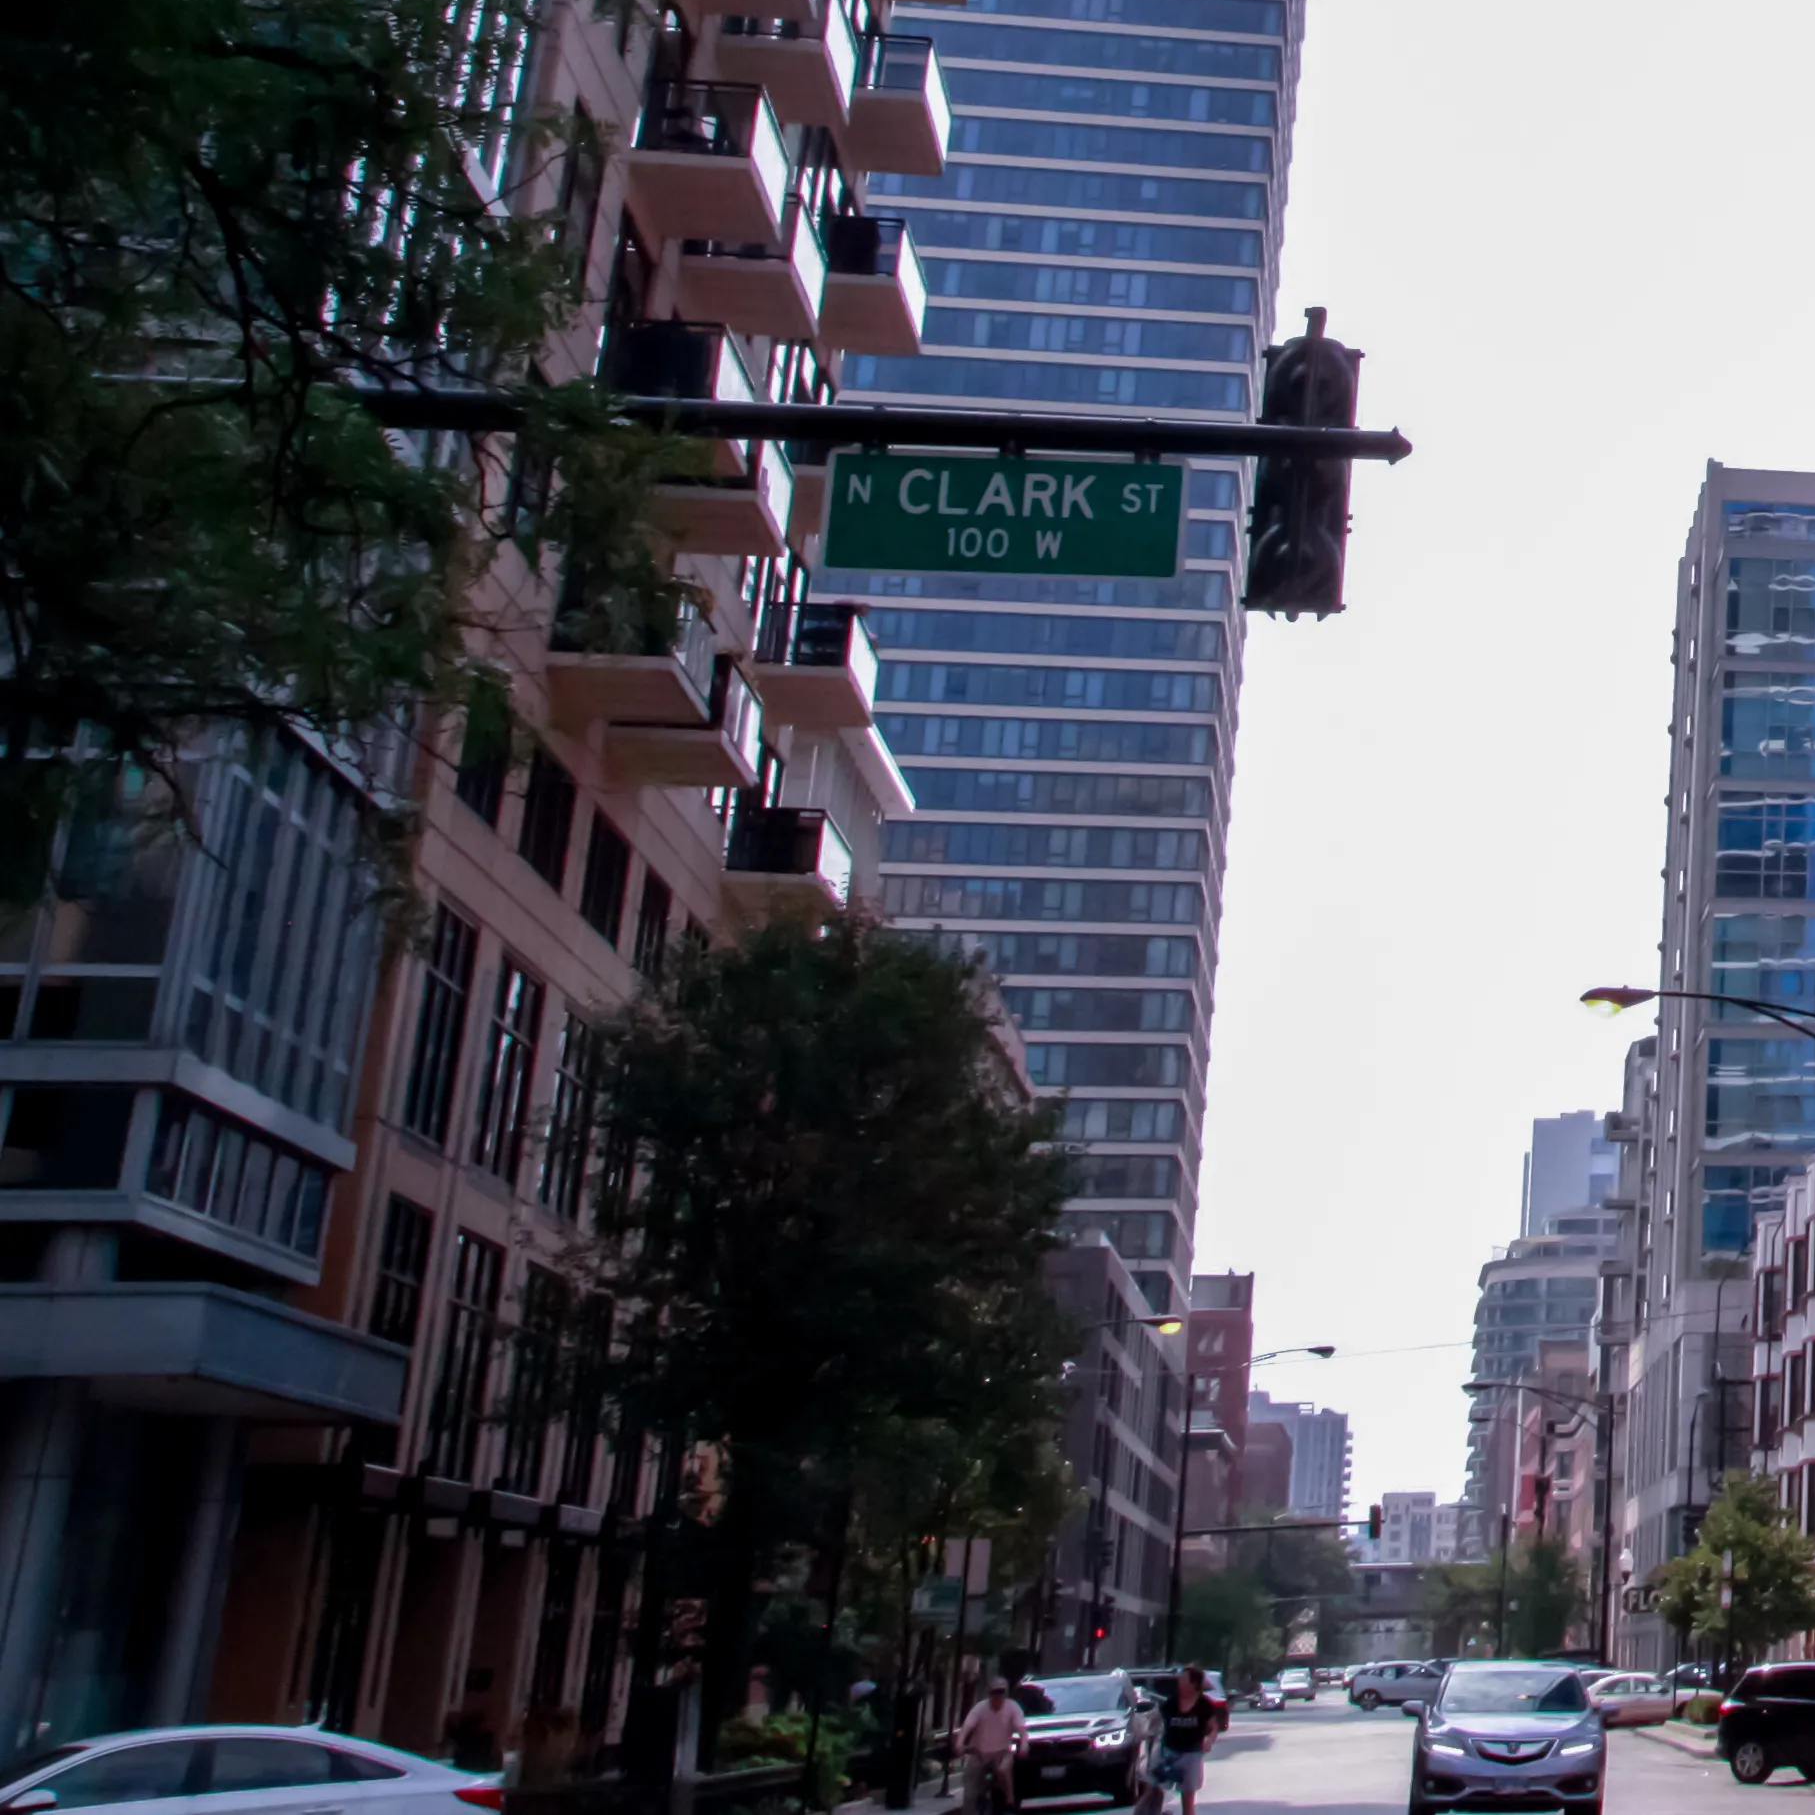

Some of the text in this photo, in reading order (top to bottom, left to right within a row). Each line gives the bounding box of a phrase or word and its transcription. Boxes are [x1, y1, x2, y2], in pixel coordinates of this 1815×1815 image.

[847, 468, 1164, 519] N CLARK ST
[947, 527, 1063, 560] 100 W
